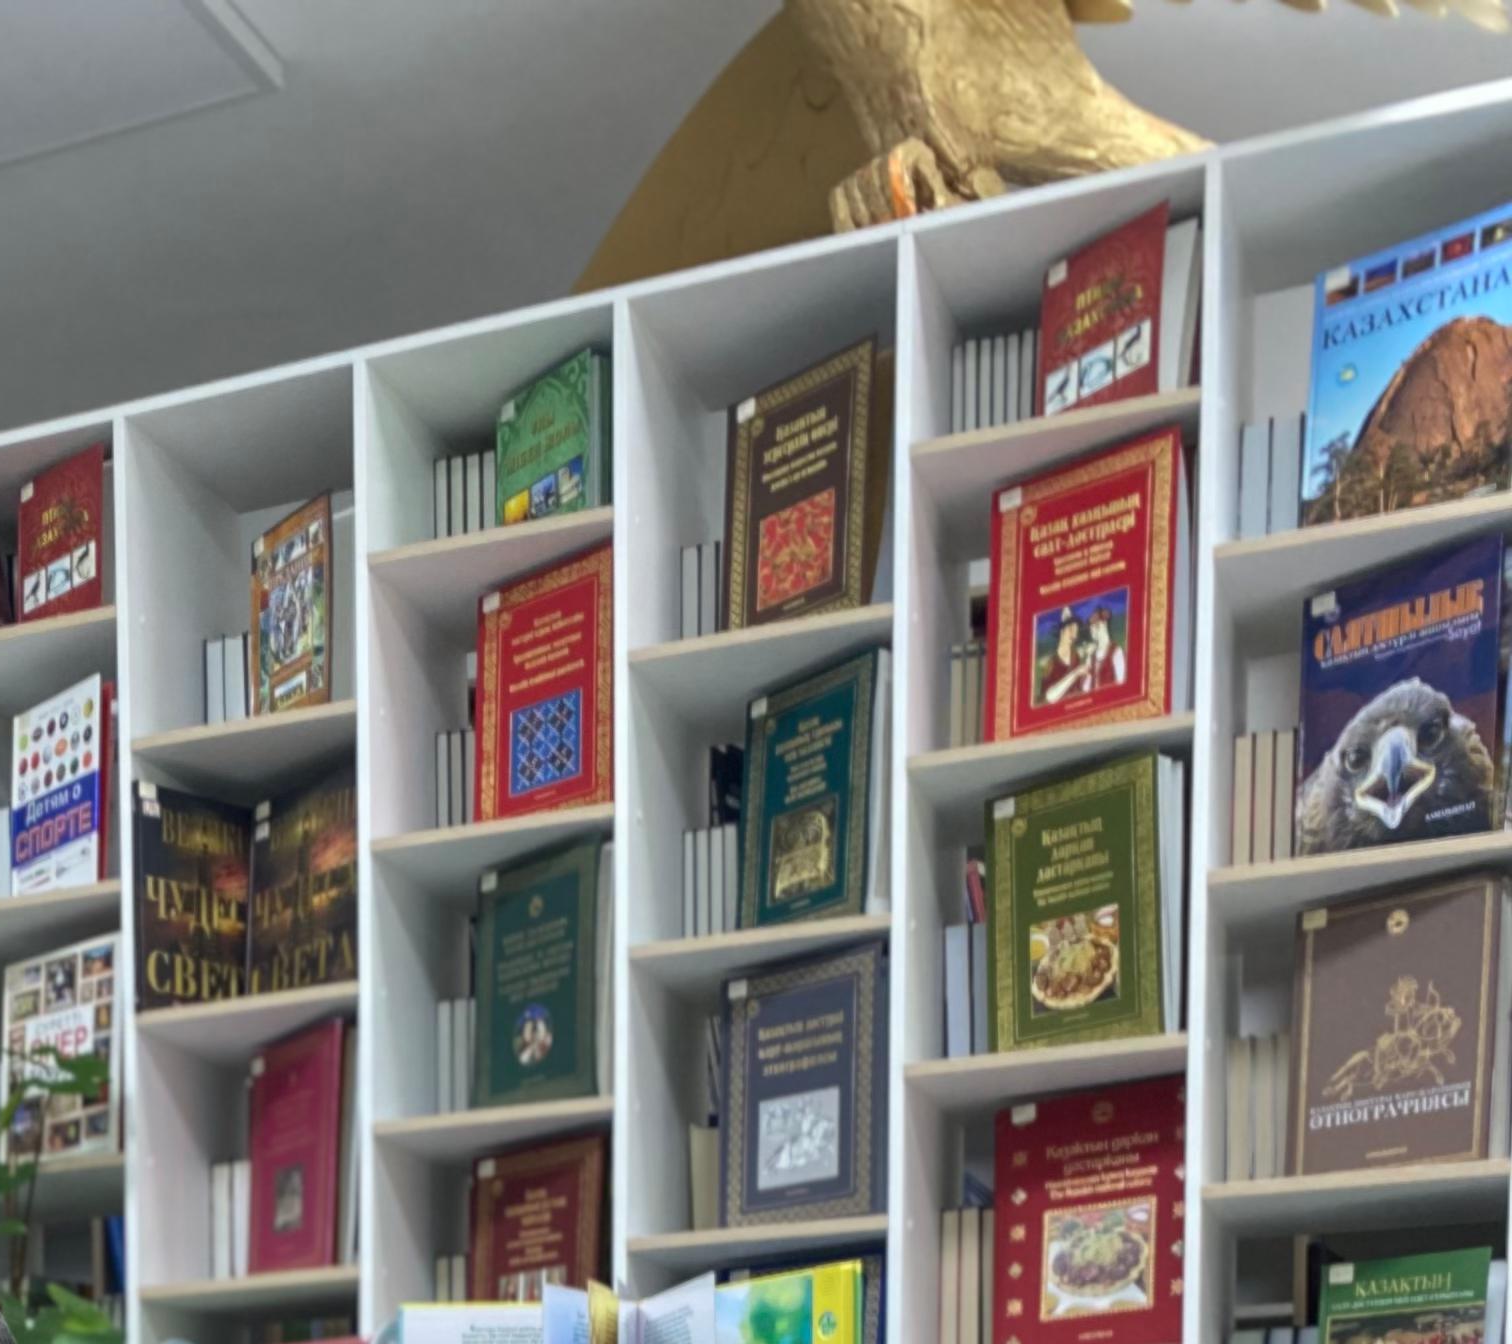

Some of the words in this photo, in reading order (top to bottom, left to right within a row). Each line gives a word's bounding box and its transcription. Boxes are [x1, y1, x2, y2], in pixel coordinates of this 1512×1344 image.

[1322, 265, 1510, 351] КАЗАХСТАНА
[15, 801, 93, 864] СПОРТЕ
[25, 789, 69, 827] Детям
